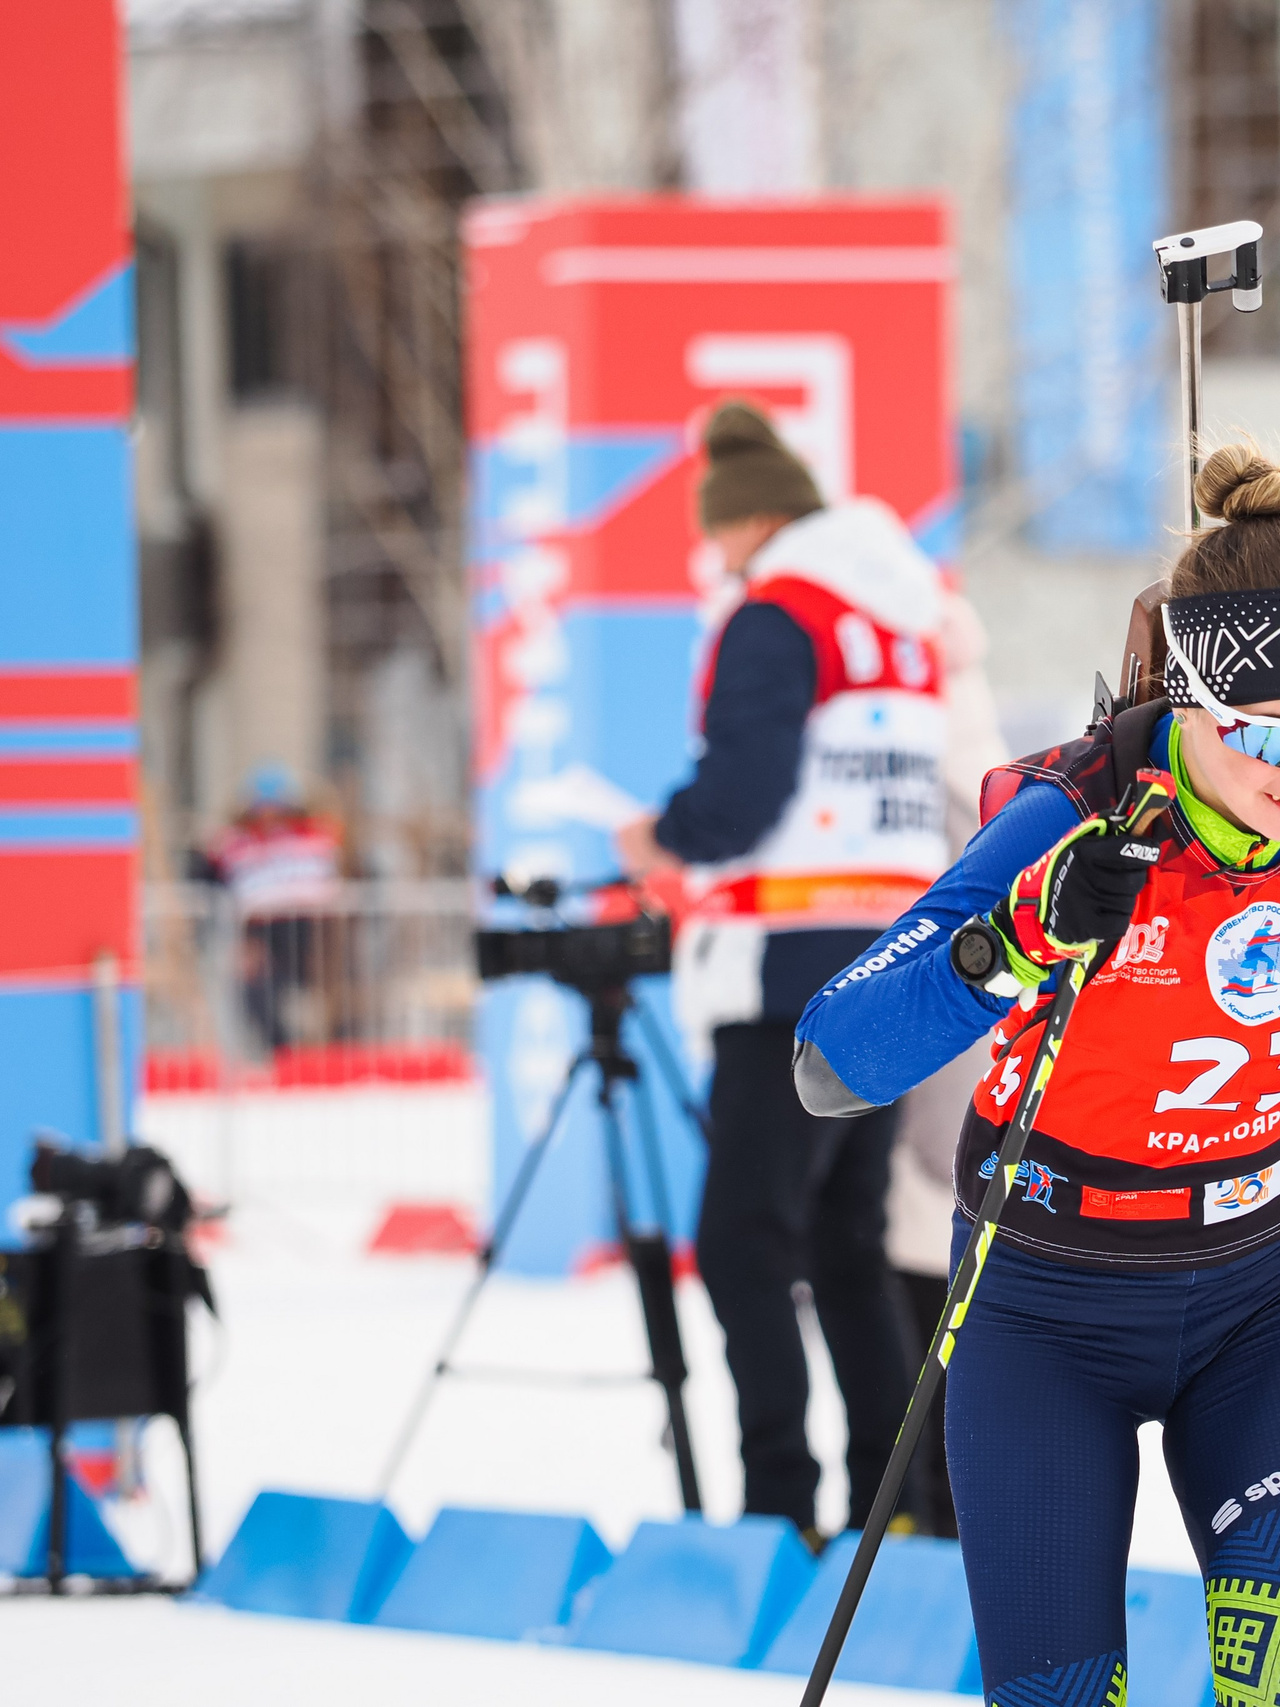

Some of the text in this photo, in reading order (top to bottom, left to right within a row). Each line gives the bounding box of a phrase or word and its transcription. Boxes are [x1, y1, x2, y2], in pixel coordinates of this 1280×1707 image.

[1214, 905, 1264, 942] ПЕРВЕНСТВО
[1148, 967, 1178, 977] СПОРТА
[1131, 975, 1181, 986] ФЕДЕРАЦИИ
